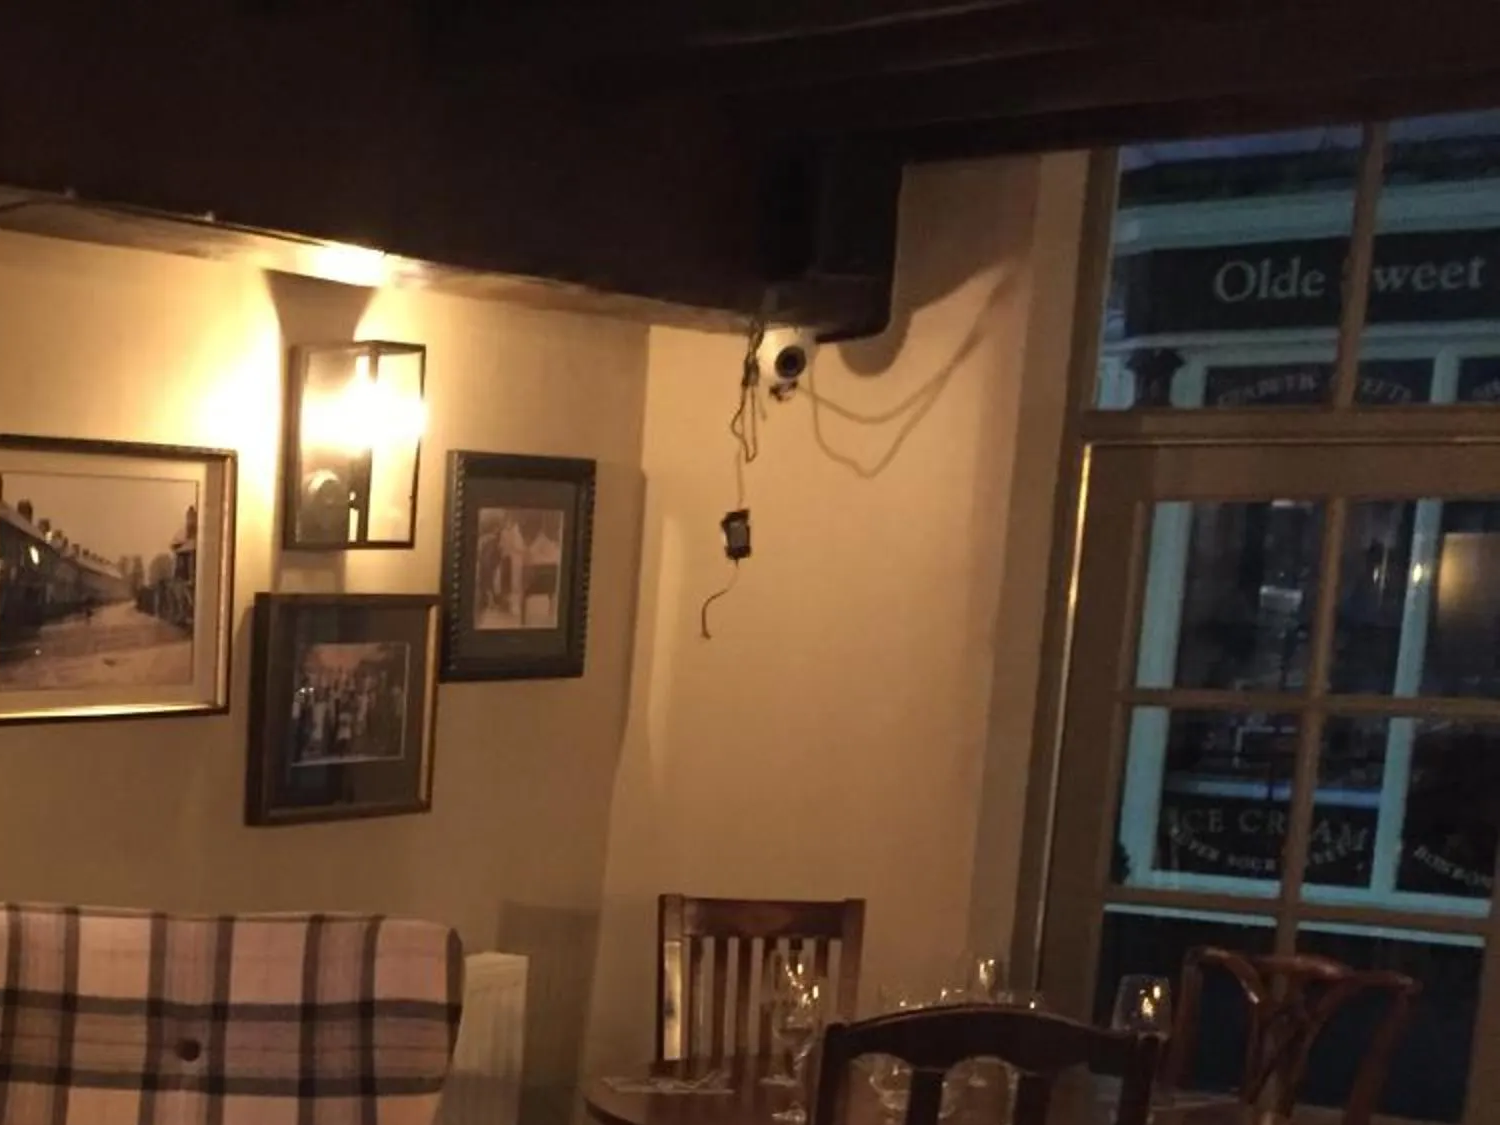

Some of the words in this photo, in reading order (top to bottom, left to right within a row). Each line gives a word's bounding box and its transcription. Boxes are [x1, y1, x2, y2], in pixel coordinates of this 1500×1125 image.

[1213, 255, 1327, 304] Olde
[1370, 254, 1488, 294] weet
[1237, 807, 1370, 852] CRAM
